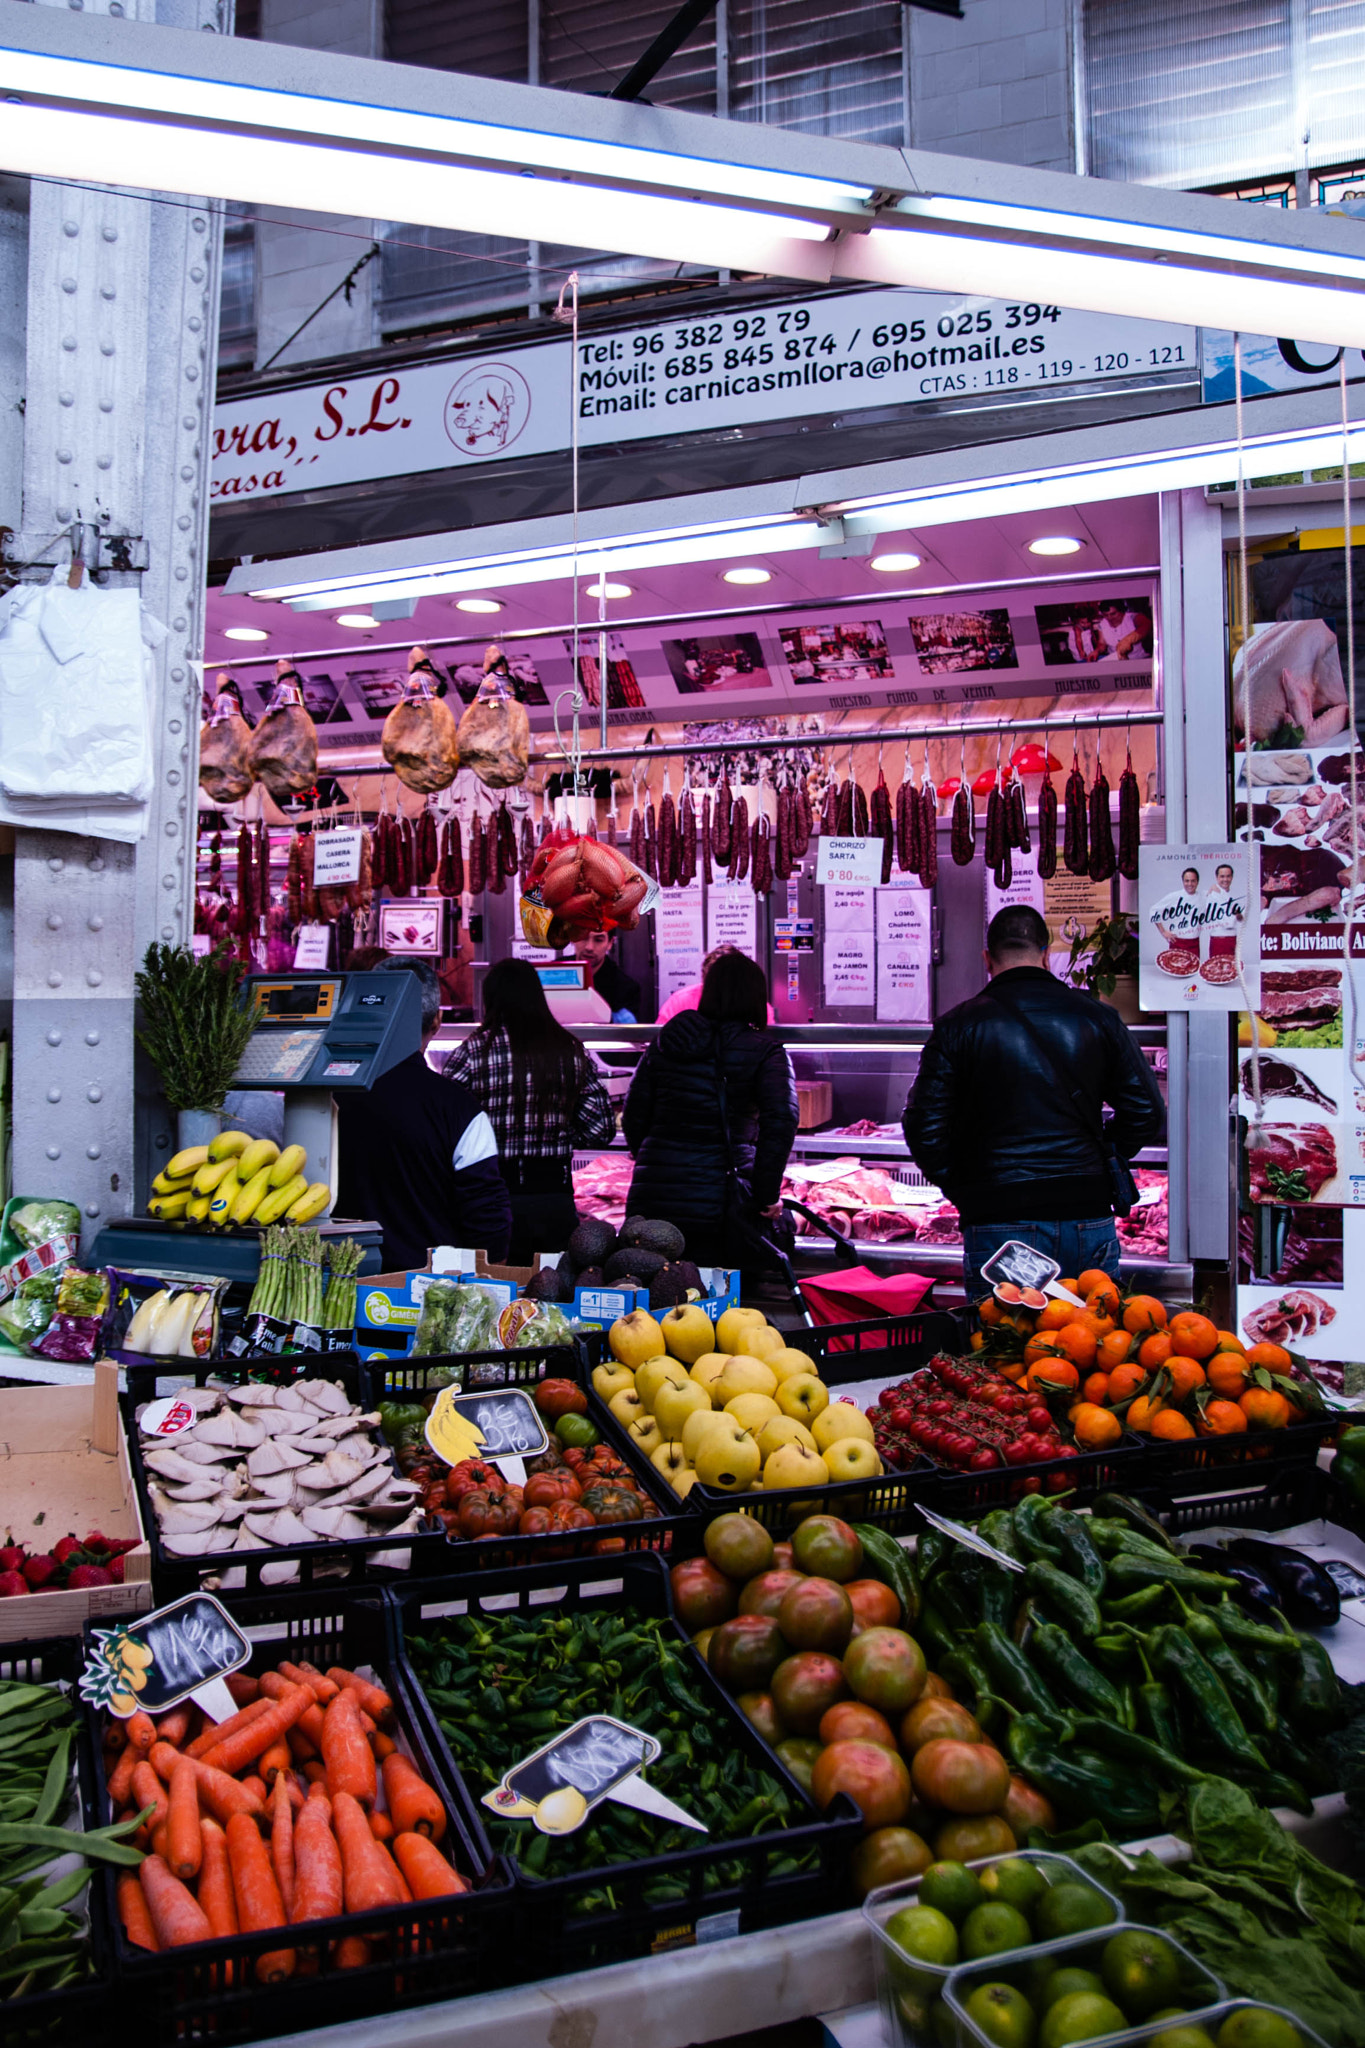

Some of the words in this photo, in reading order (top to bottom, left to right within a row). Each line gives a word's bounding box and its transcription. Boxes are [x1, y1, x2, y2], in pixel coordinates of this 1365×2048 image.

[579, 340, 623, 365] Tel:
[633, 333, 664, 357] 96
[675, 323, 723, 349] 382
[733, 316, 766, 340] 92
[777, 309, 811, 333] 79
[580, 362, 655, 392] Móvil:
[664, 352, 714, 379] 685
[723, 343, 774, 370] 845
[784, 333, 837, 360] 874
[872, 319, 926, 347] 695
[937, 310, 992, 338] 025
[1005, 303, 1062, 329] 394
[580, 388, 656, 418] Email:
[664, 335, 1046, 406] carnicasmllora@hotmail.es
[919, 374, 967, 395] CTAS
[984, 367, 1019, 387] 118
[1037, 360, 1073, 380] 119
[1094, 353, 1129, 373] 120
[1149, 345, 1186, 366] 121
[314, 378, 412, 441] S.L.
[829, 695, 872, 709] NUESTRO
[933, 689, 946, 701] DE
[962, 685, 996, 699] VENTA
[1055, 678, 1100, 693] NUESTRO
[588, 712, 629, 726] NUSTRA
[829, 841, 866, 849] CHORIZO
[829, 852, 855, 860] SARTA
[1200, 852, 1243, 860] IBÉRICOS
[1151, 911, 1161, 923] de
[1162, 896, 1195, 922] cebo
[1178, 916, 1189, 930] de
[1190, 895, 1247, 927] bellota
[1281, 931, 1345, 951] Boliviano
